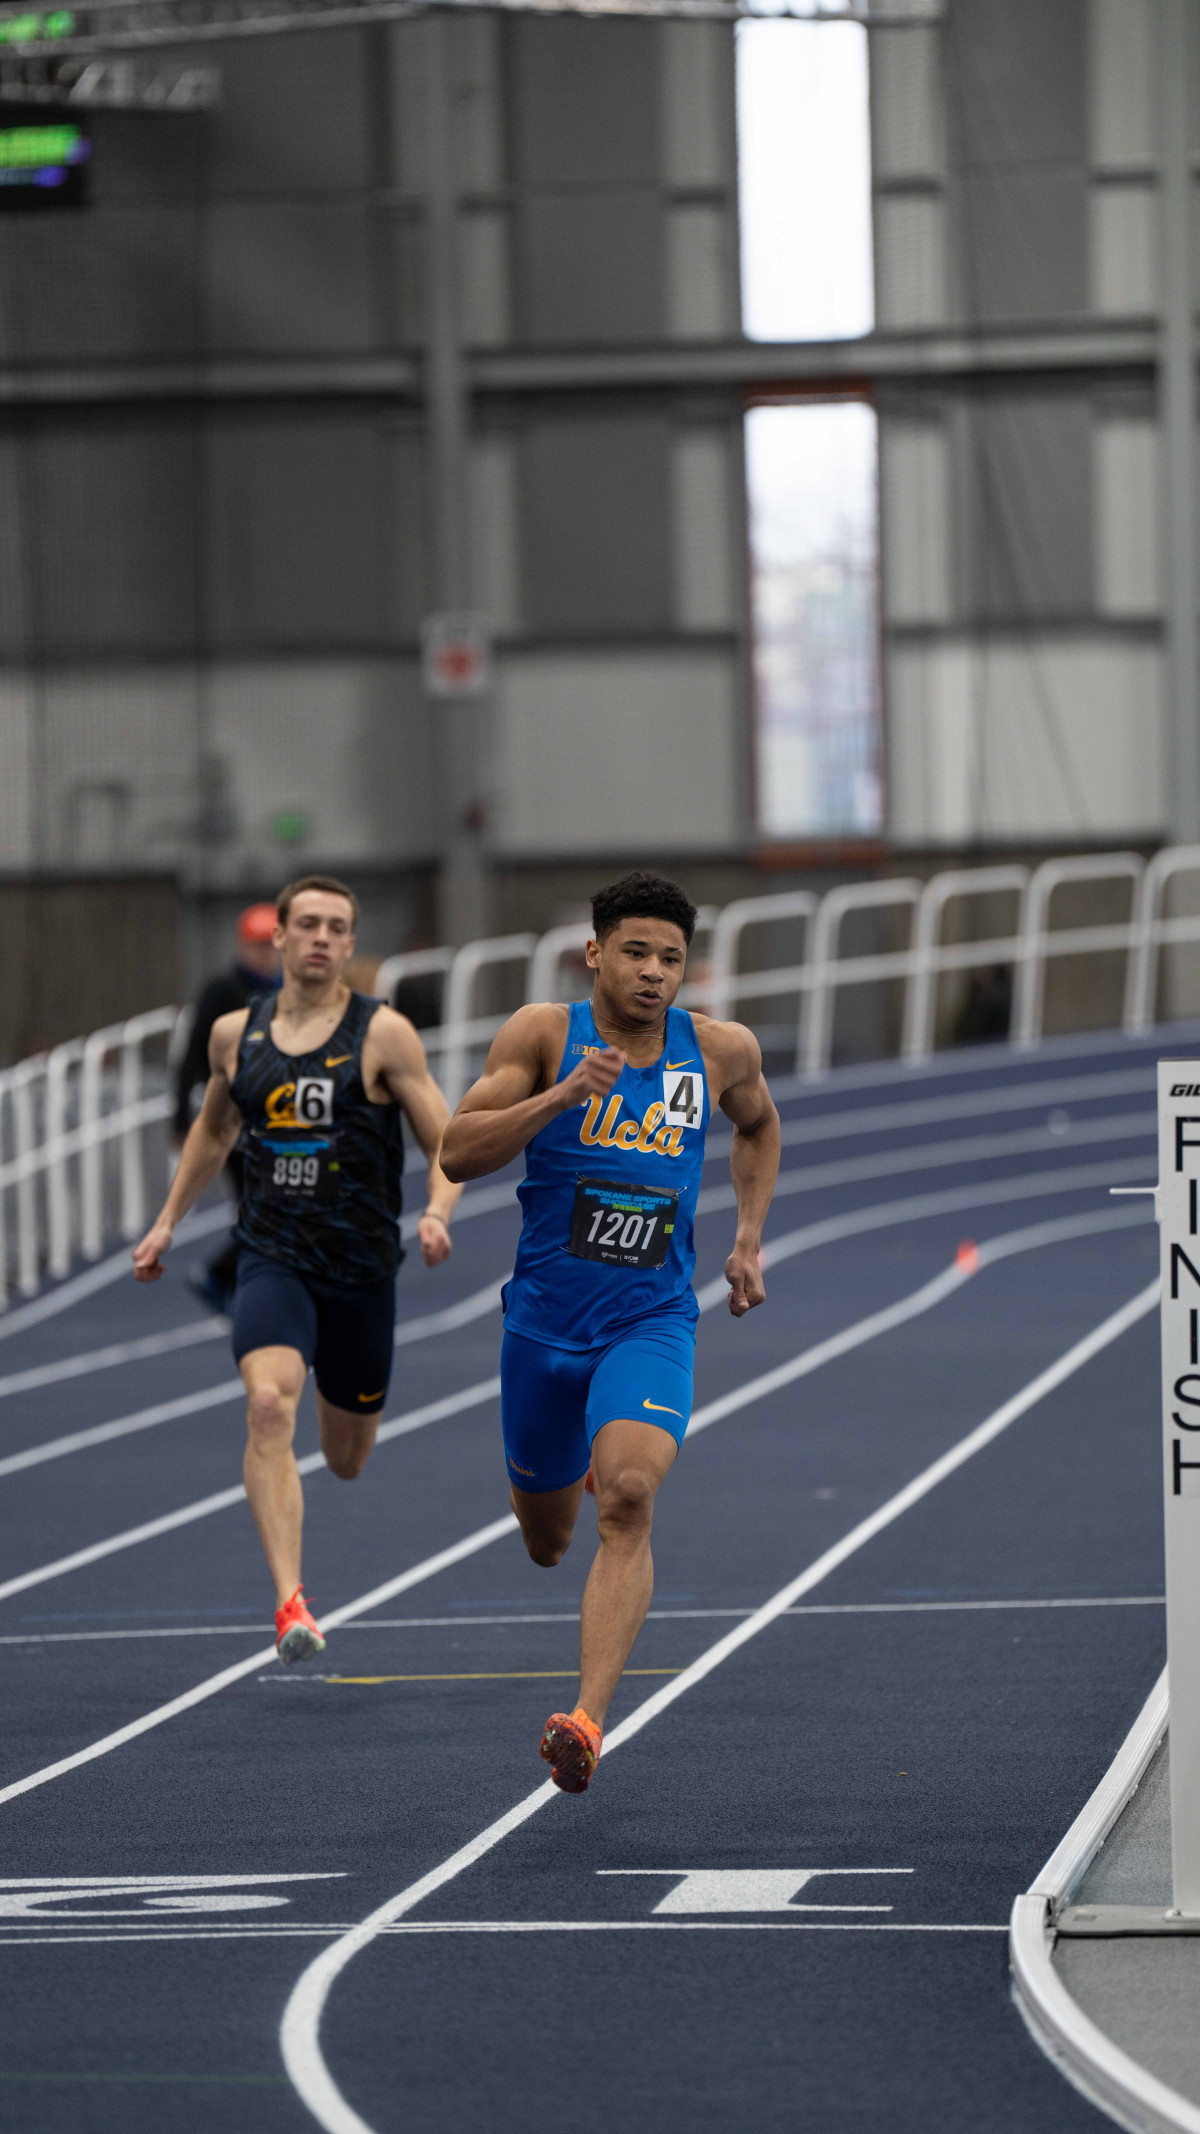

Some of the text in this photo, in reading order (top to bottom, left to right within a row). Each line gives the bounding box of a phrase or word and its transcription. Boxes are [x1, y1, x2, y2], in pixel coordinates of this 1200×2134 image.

[301, 1083, 325, 1121] 6
[669, 1075, 698, 1124] 4
[580, 1092, 684, 1157] Ucla
[272, 1157, 320, 1187] 899
[585, 1188, 672, 1205] SPOKANE SPORTS
[600, 1197, 656, 1210] SHOWCASE
[587, 1209, 658, 1250] 1201
